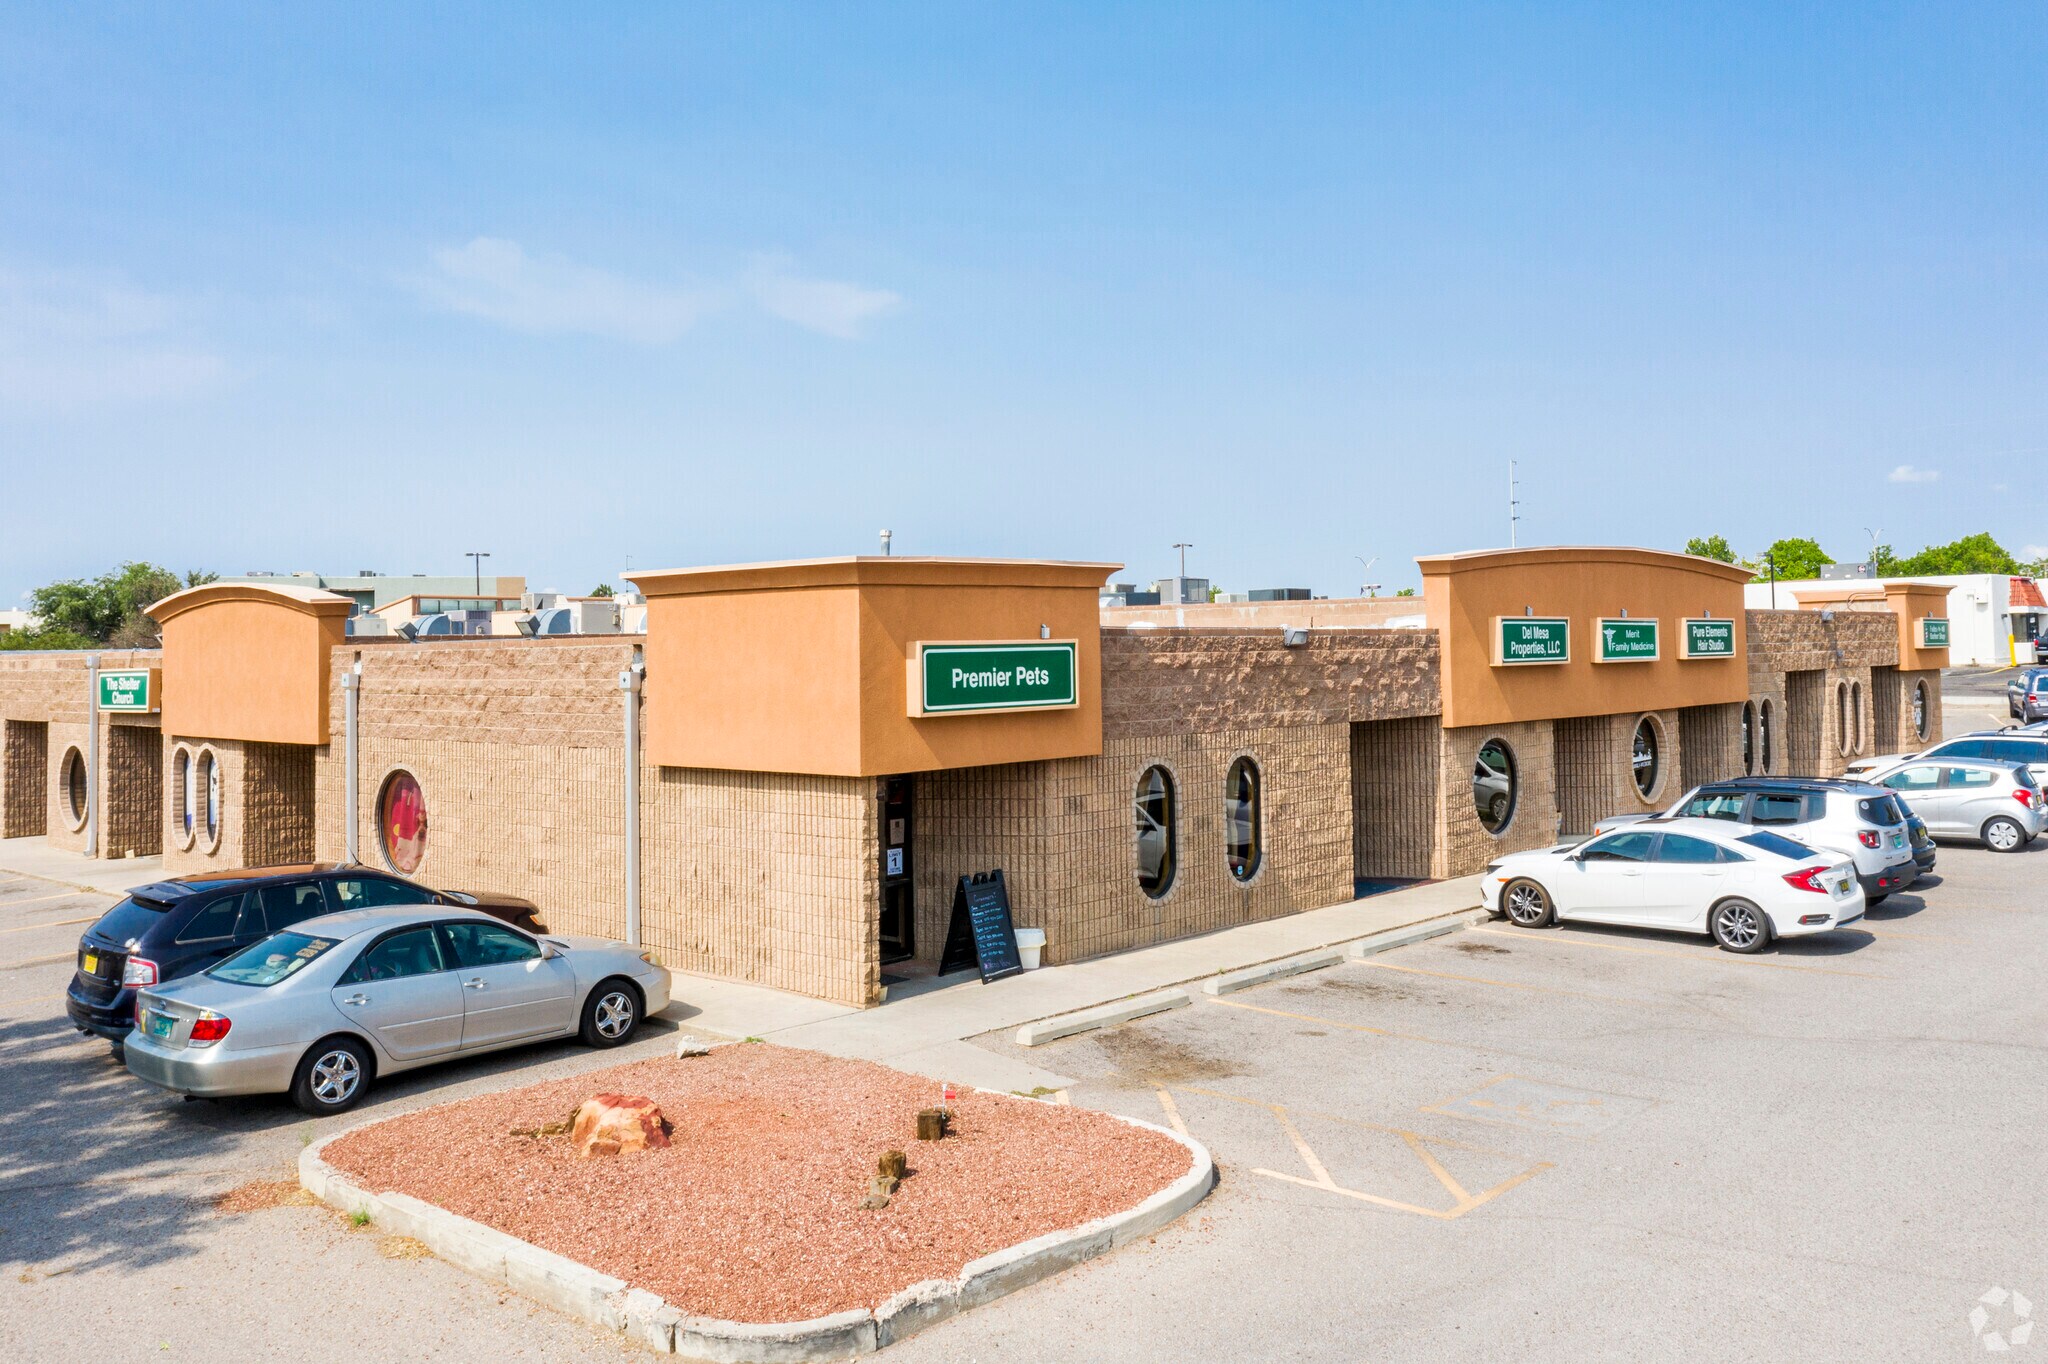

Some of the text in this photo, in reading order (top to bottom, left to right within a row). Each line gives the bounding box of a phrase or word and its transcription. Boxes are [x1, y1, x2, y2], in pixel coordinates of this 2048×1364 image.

[1522, 626, 1549, 639] Del Mesa
[1625, 629, 1640, 638] Merit
[1693, 626, 1728, 637] Pure Elements
[1511, 640, 1560, 657] Properties, LLC
[1611, 642, 1654, 653] Family Medicine
[1697, 639, 1725, 651] Hair Studio
[952, 666, 1049, 688] Premier Pets
[106, 677, 140, 690] The Shelter
[112, 691, 134, 704] Church
[891, 857, 897, 867] 1
